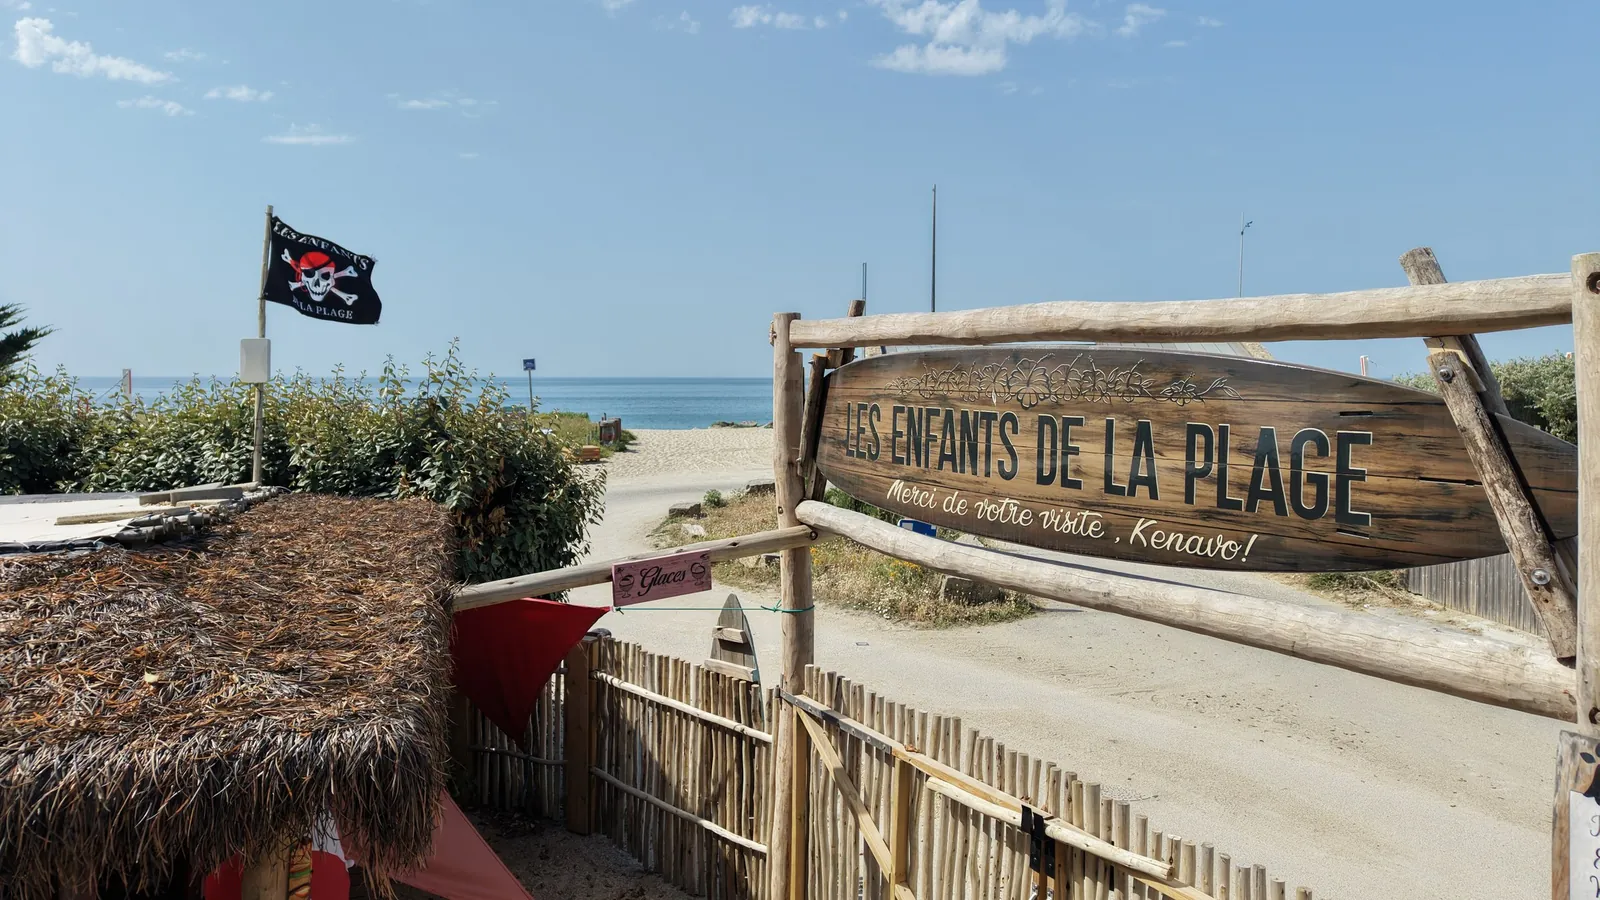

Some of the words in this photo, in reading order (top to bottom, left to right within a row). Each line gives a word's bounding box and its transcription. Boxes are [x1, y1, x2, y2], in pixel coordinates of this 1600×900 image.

[273, 221, 299, 240] LES
[298, 235, 369, 270] ENFANTS
[300, 301, 313, 312] LA
[316, 305, 353, 319] PLAGE
[845, 402, 881, 462] LES
[891, 404, 1019, 481] ENFANTS
[1036, 413, 1085, 491] DE
[1103, 417, 1160, 501] LA
[1184, 421, 1373, 527] PLAGE
[887, 480, 937, 509] Merci
[943, 491, 969, 515] de
[974, 498, 1034, 526] votre
[1129, 517, 1259, 563] Kenavo!
[637, 566, 687, 597] Glaces
